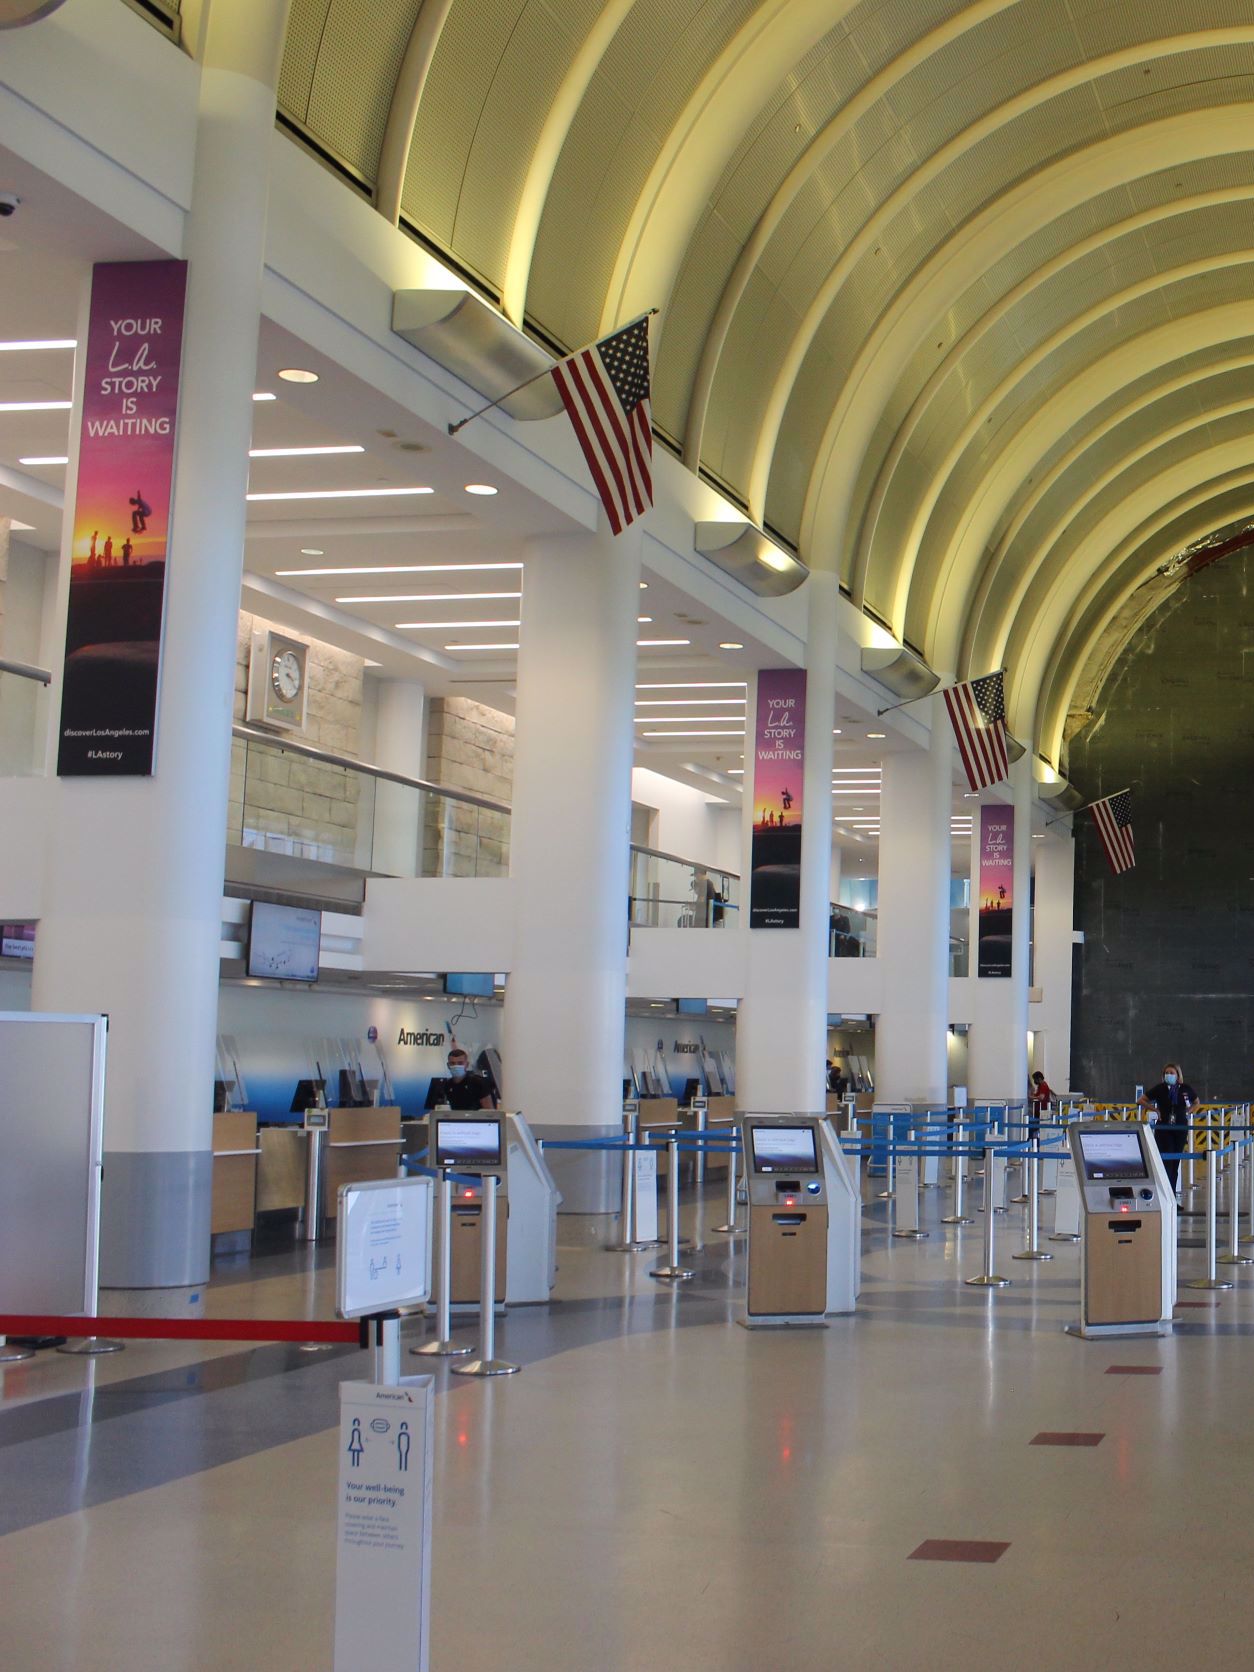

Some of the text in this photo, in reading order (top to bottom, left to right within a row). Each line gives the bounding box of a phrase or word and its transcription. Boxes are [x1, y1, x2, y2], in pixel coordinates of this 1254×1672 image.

[110, 318, 162, 336] YOUR
[100, 376, 162, 395] STORY
[122, 398, 137, 415] IS
[87, 417, 170, 437] WAITING
[768, 699, 796, 708] YOUR
[64, 728, 150, 737] discoverLosAngeles.com
[764, 729, 796, 739] STORY
[775, 739, 784, 749] IS
[87, 750, 123, 760] #LAstory
[758, 750, 802, 760] WAITING
[982, 859, 1012, 867] WAITING
[397, 1027, 445, 1046] American
[376, 1392, 404, 1400] American
[346, 1481, 405, 1496] Your well-being
[346, 1493, 352, 1502] is
[368, 1497, 396, 1509] priority
